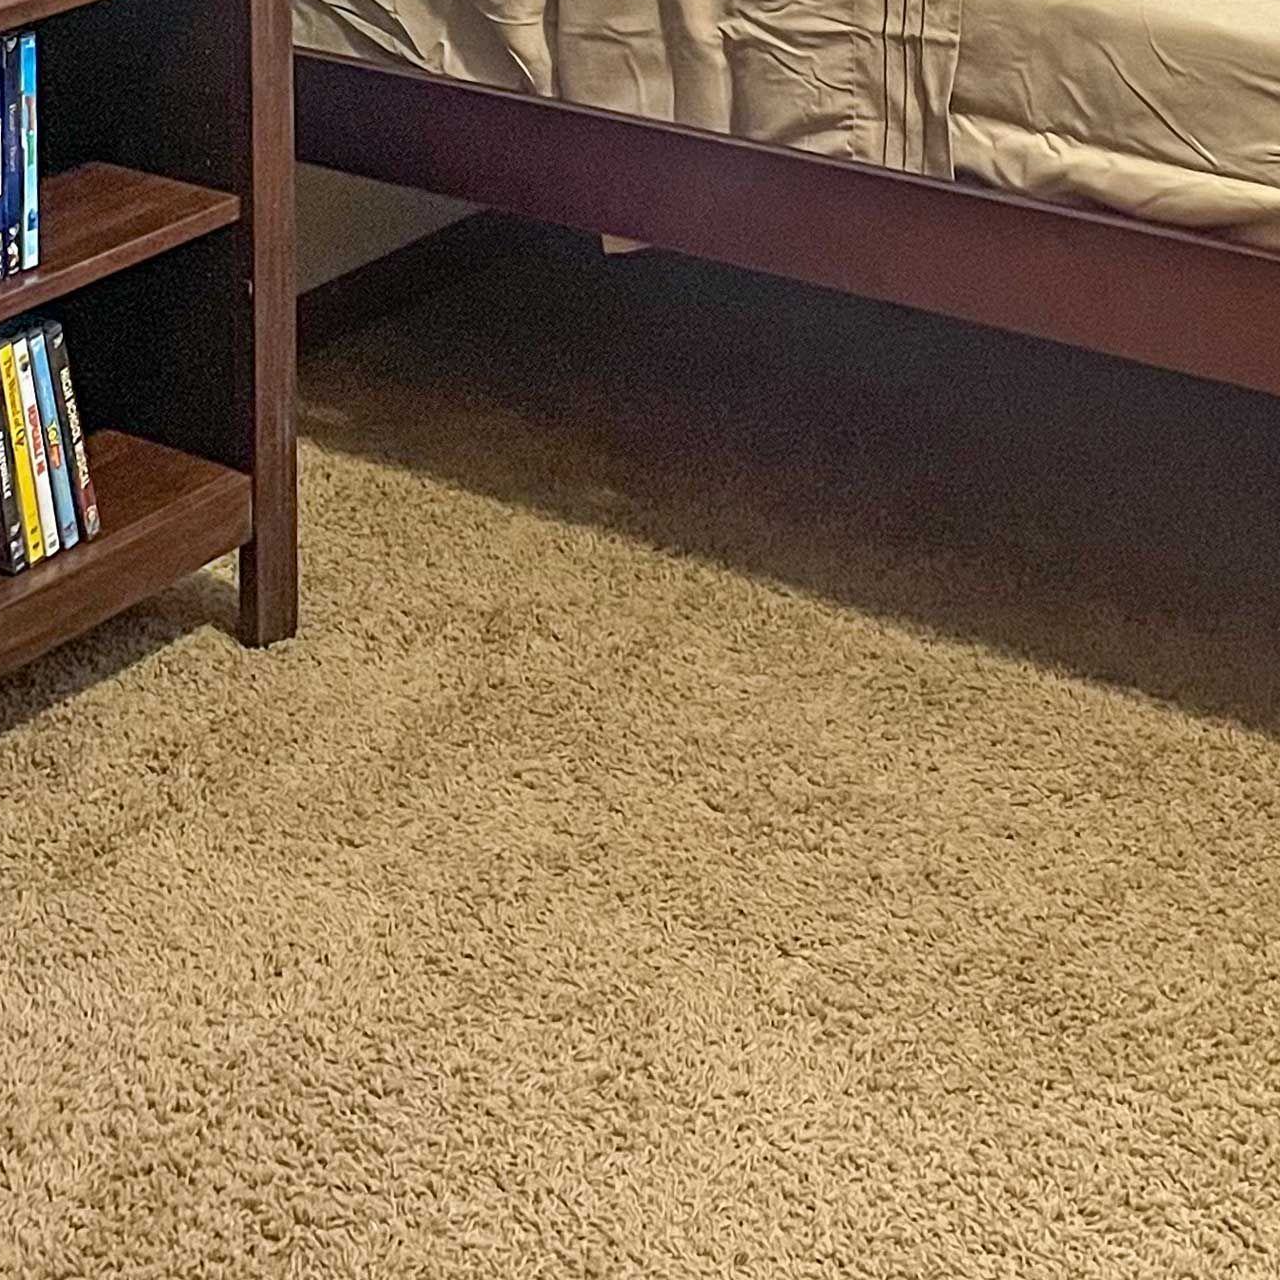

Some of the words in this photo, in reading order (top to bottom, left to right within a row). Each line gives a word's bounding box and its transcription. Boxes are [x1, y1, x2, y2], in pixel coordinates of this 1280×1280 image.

[3, 356, 15, 380] The
[5, 380, 20, 419] Wizard
[47, 420, 60, 445] TOY
